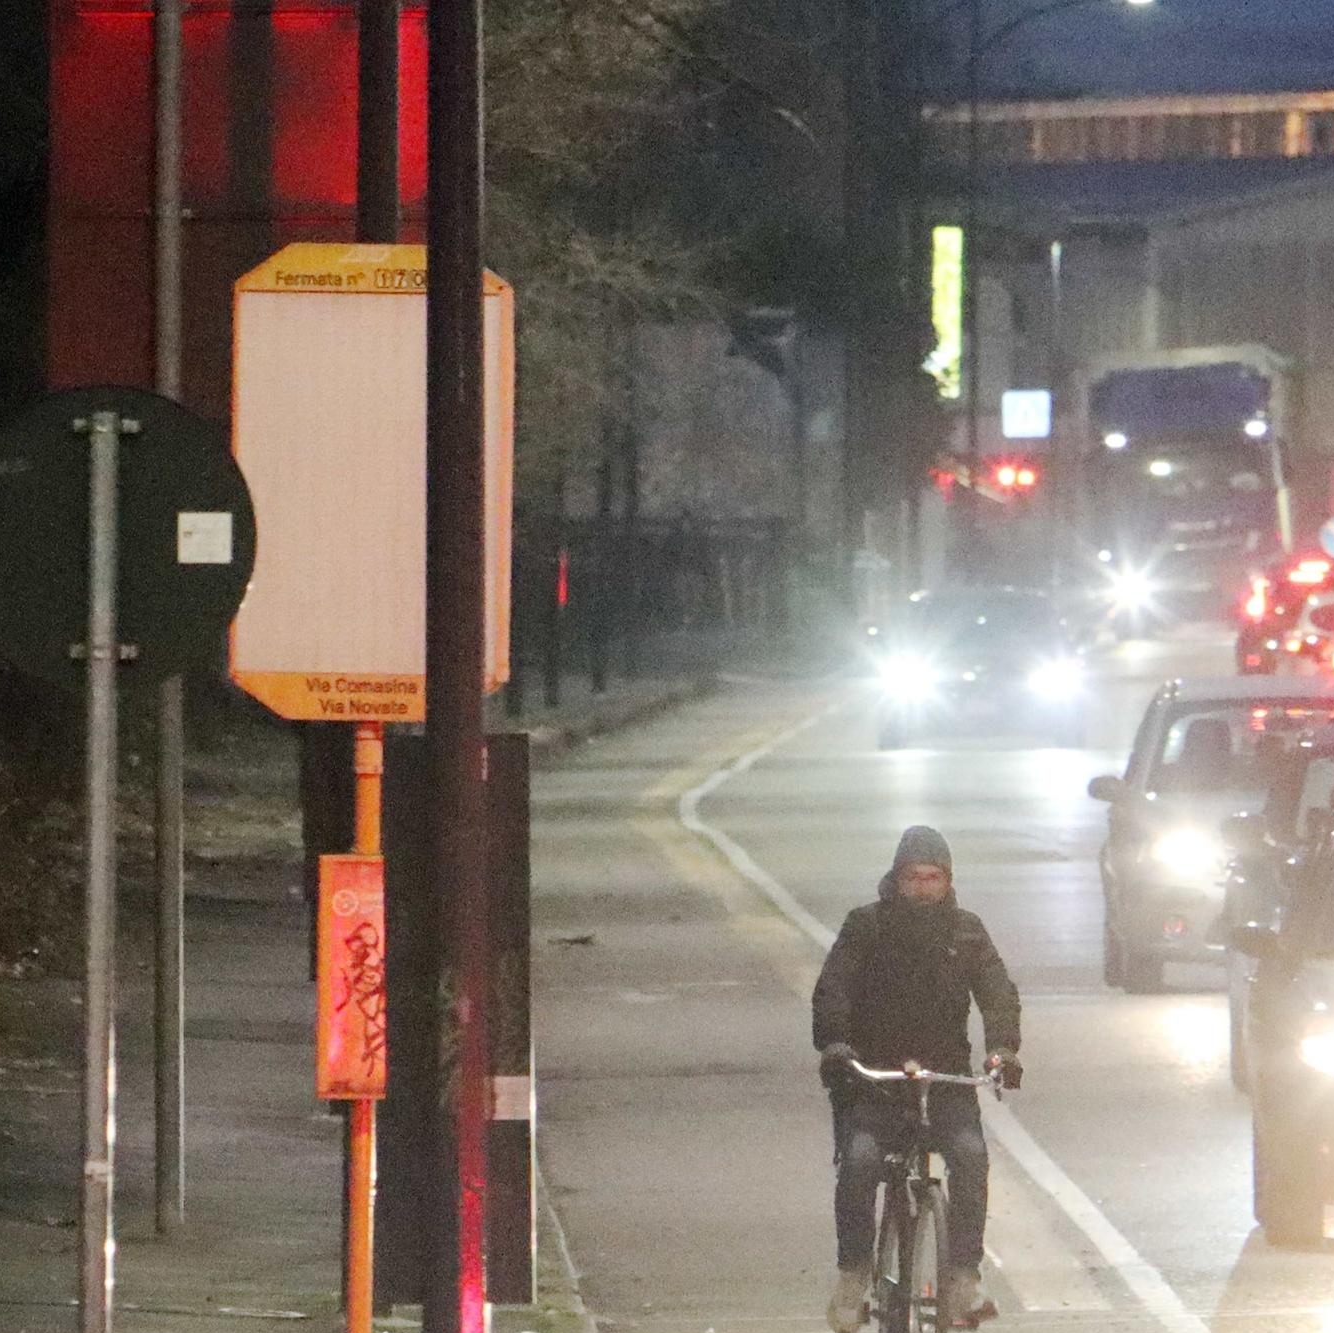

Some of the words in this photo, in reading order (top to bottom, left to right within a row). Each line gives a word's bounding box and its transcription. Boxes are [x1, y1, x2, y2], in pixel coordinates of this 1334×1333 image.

[275, 271, 342, 286] Fermata
[306, 678, 331, 693] Via
[335, 678, 419, 694] Comasina
[317, 699, 345, 714] Via
[349, 699, 409, 715] Novate
